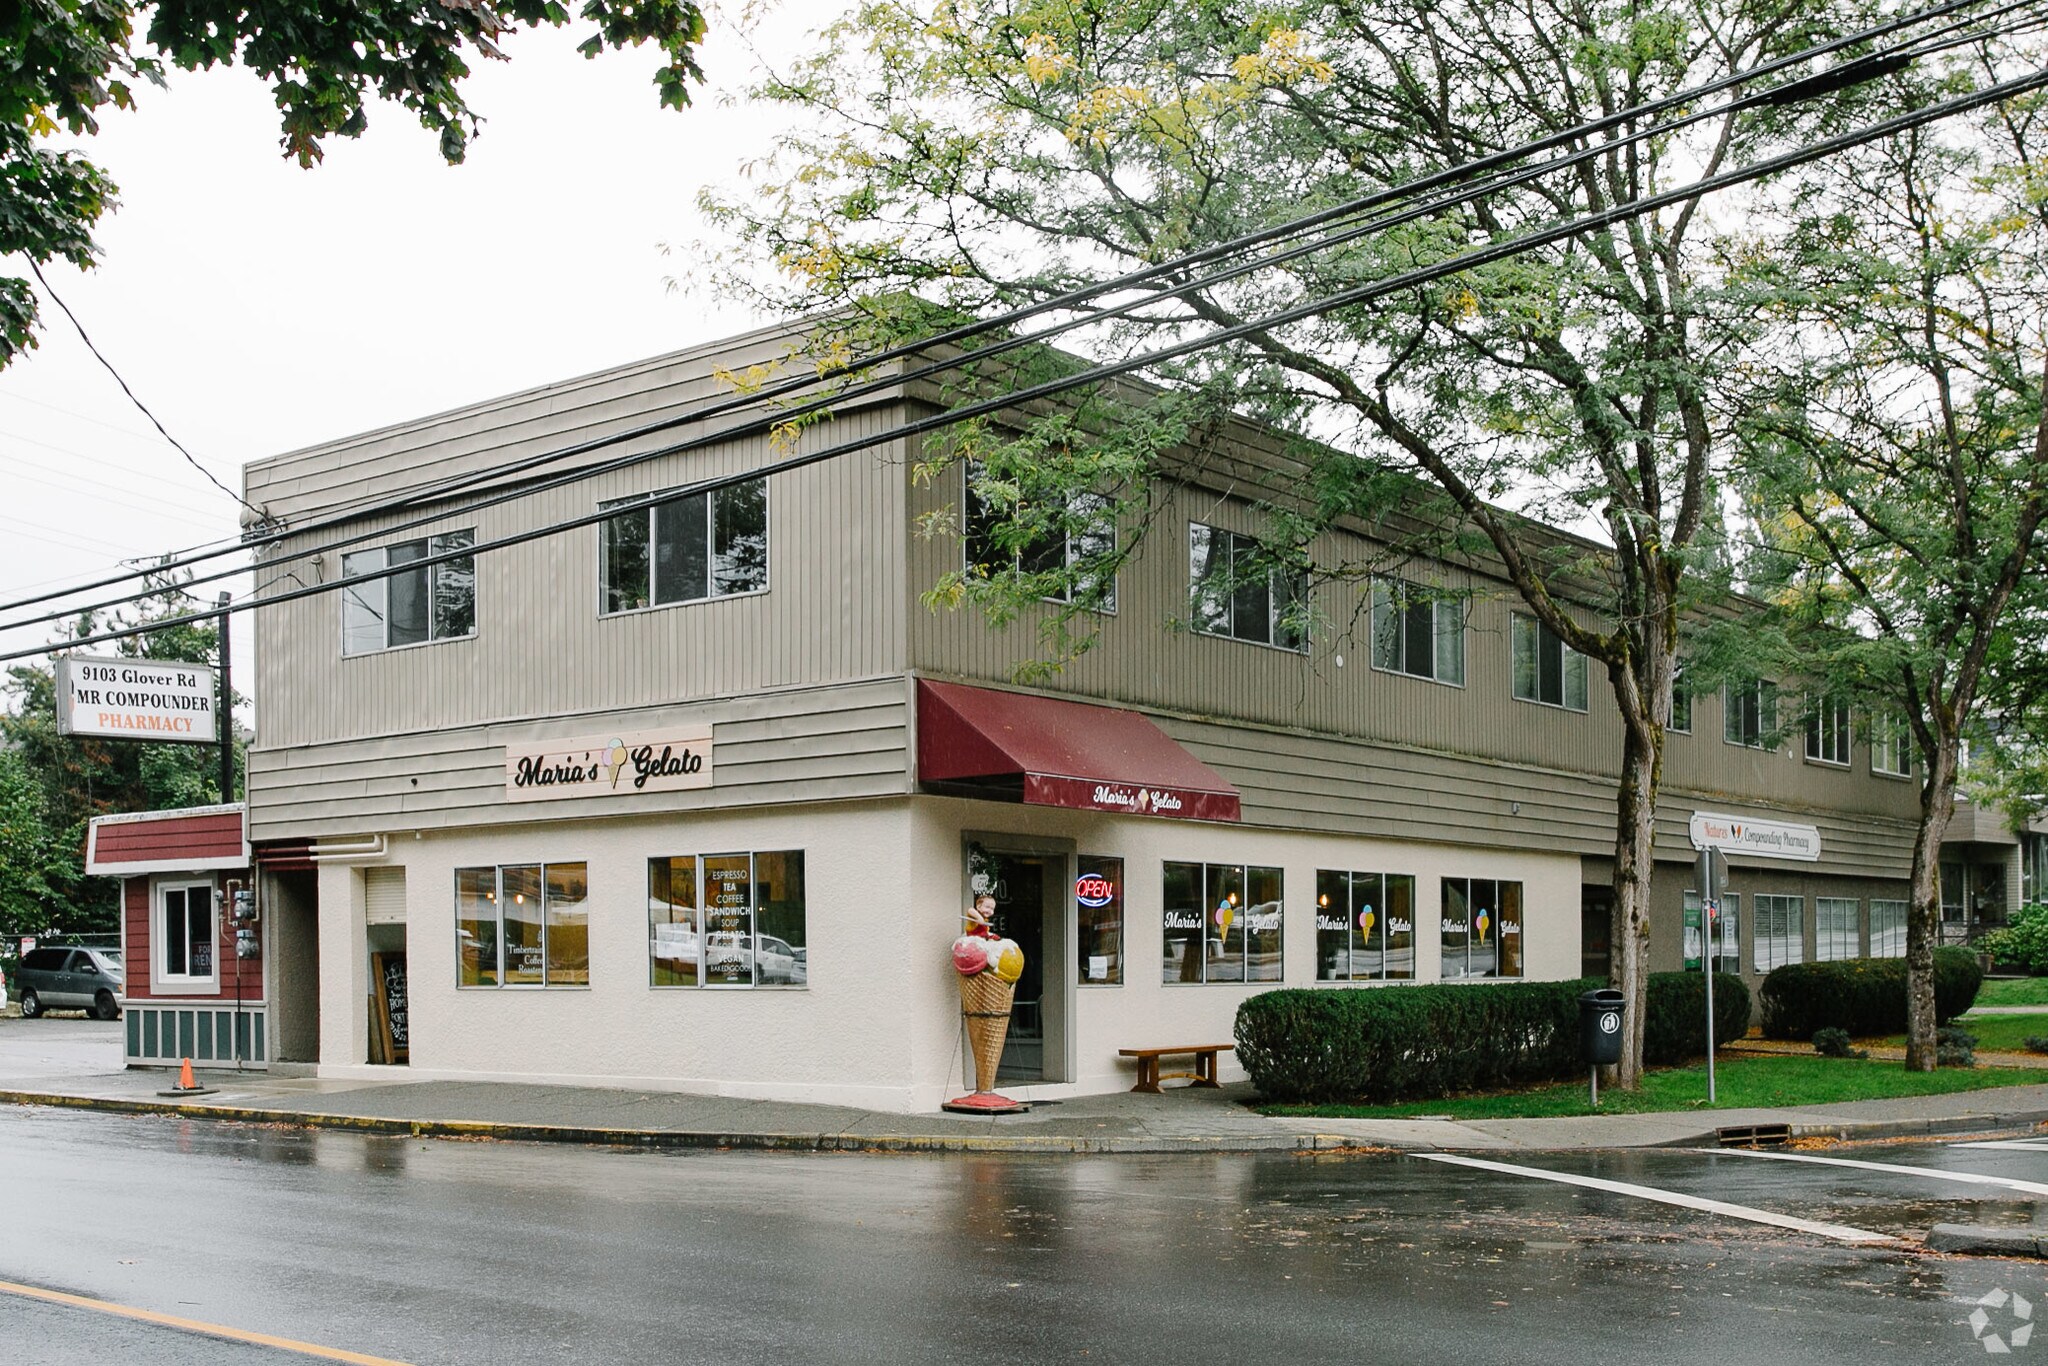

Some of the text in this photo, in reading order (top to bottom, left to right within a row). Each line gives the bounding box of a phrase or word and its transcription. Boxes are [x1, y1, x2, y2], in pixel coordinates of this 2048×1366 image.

[82, 666, 197, 688] 9103 Glover Rd
[77, 689, 210, 711] MR COMPOUNDER
[98, 713, 193, 732] PHARMACY
[514, 745, 702, 788] Maria's Gelato
[1093, 785, 1182, 813] Maria's Gelato
[1744, 827, 1782, 850] Compounding
[1783, 831, 1810, 852] Pharmacy
[712, 870, 748, 880] ESPRESSO
[723, 882, 737, 892] TEA
[1076, 879, 1113, 898] OPEN
[716, 894, 744, 904] COFFEE
[709, 906, 751, 916] SANDWICH
[721, 918, 740, 928] SOUP
[1164, 911, 1279, 935] Maria's Gelato
[1317, 914, 1412, 937] Maria's Gelato
[1441, 918, 1520, 938] Maria's Gelato
[194, 954, 212, 967] REN
